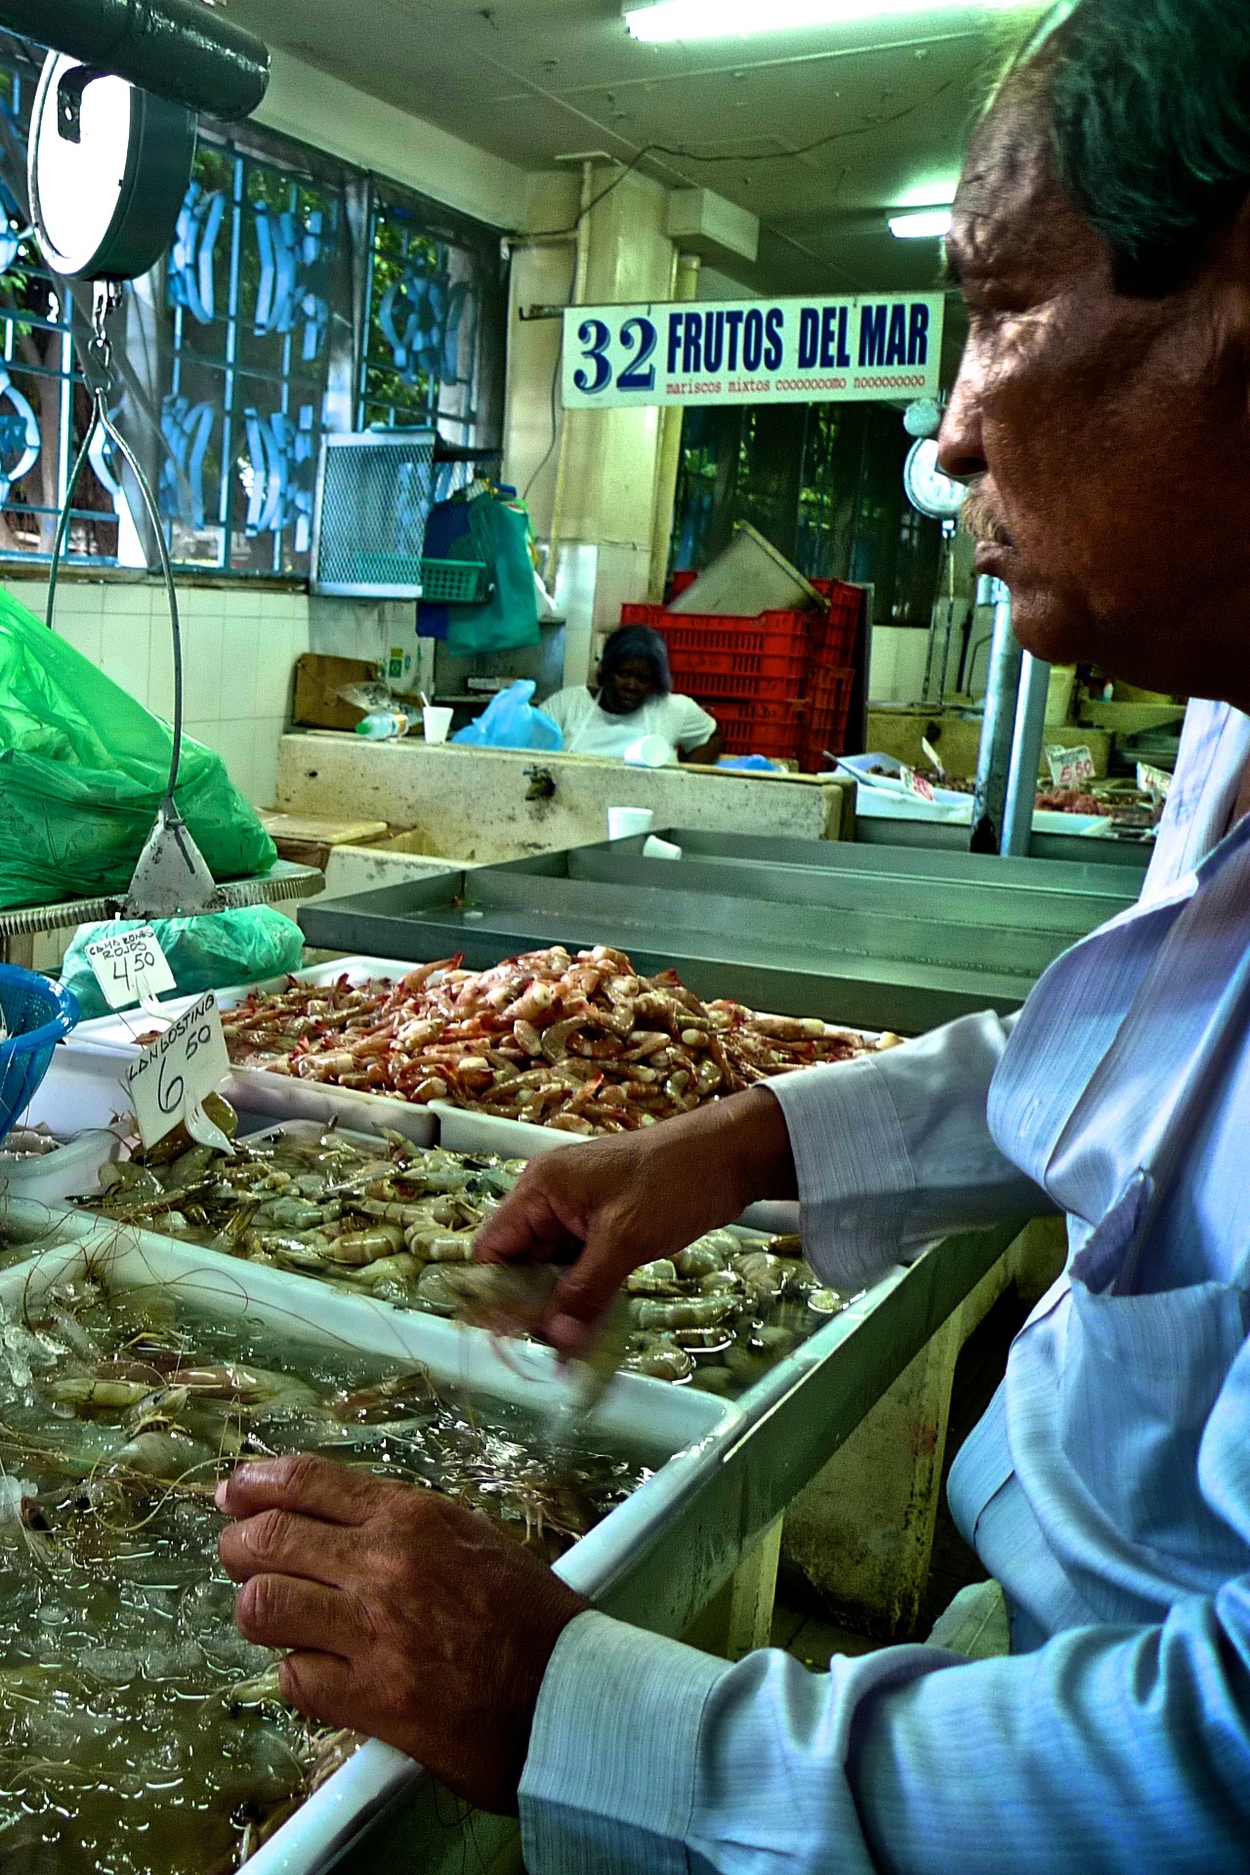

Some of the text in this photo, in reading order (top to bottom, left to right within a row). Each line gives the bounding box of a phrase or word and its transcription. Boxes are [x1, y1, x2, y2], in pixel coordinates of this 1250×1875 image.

[573, 303, 930, 395] 32 FRUTOS DEL MAR
[666, 379, 722, 395] mariscos
[728, 376, 771, 392] mixtos
[102, 941, 147, 960] ROJOS
[129, 994, 214, 1081] LANGOSTINO
